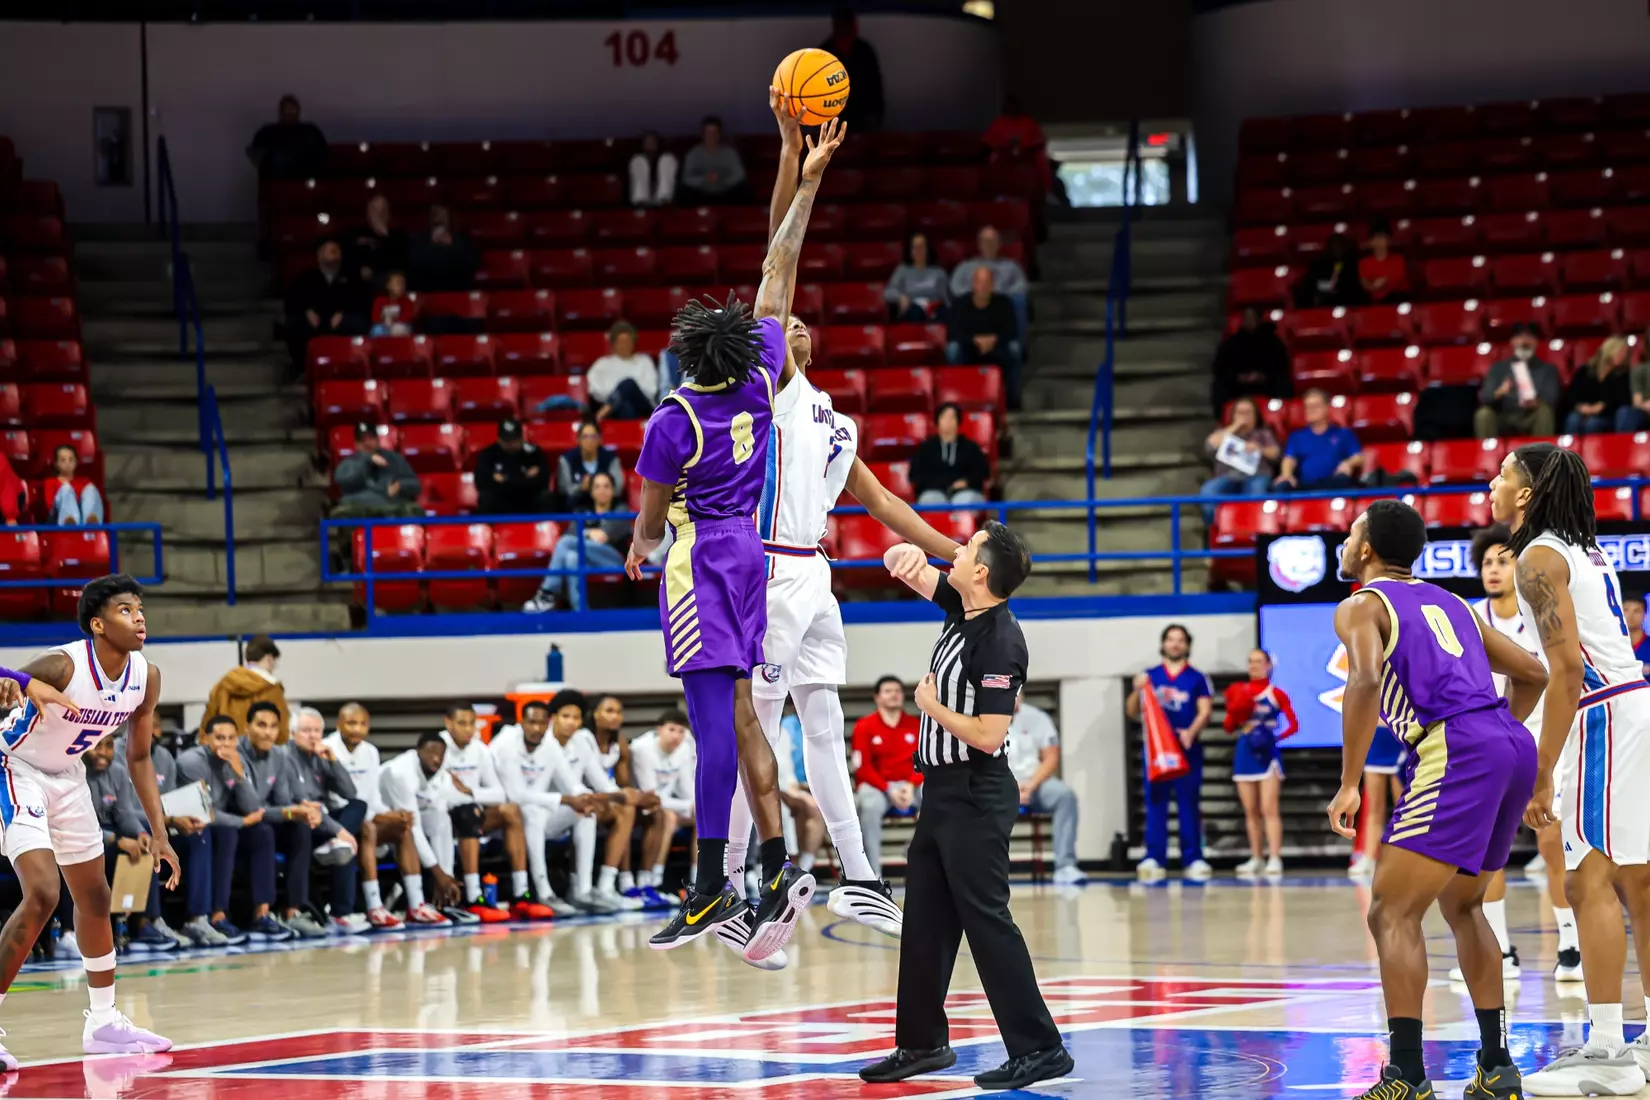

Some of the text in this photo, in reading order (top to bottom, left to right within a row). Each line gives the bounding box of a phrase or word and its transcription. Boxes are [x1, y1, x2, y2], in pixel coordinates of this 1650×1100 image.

[603, 28, 681, 67] 104
[730, 410, 755, 465] 8
[1420, 604, 1465, 658] 0
[1602, 572, 1629, 637] 4
[65, 729, 103, 755] 5
